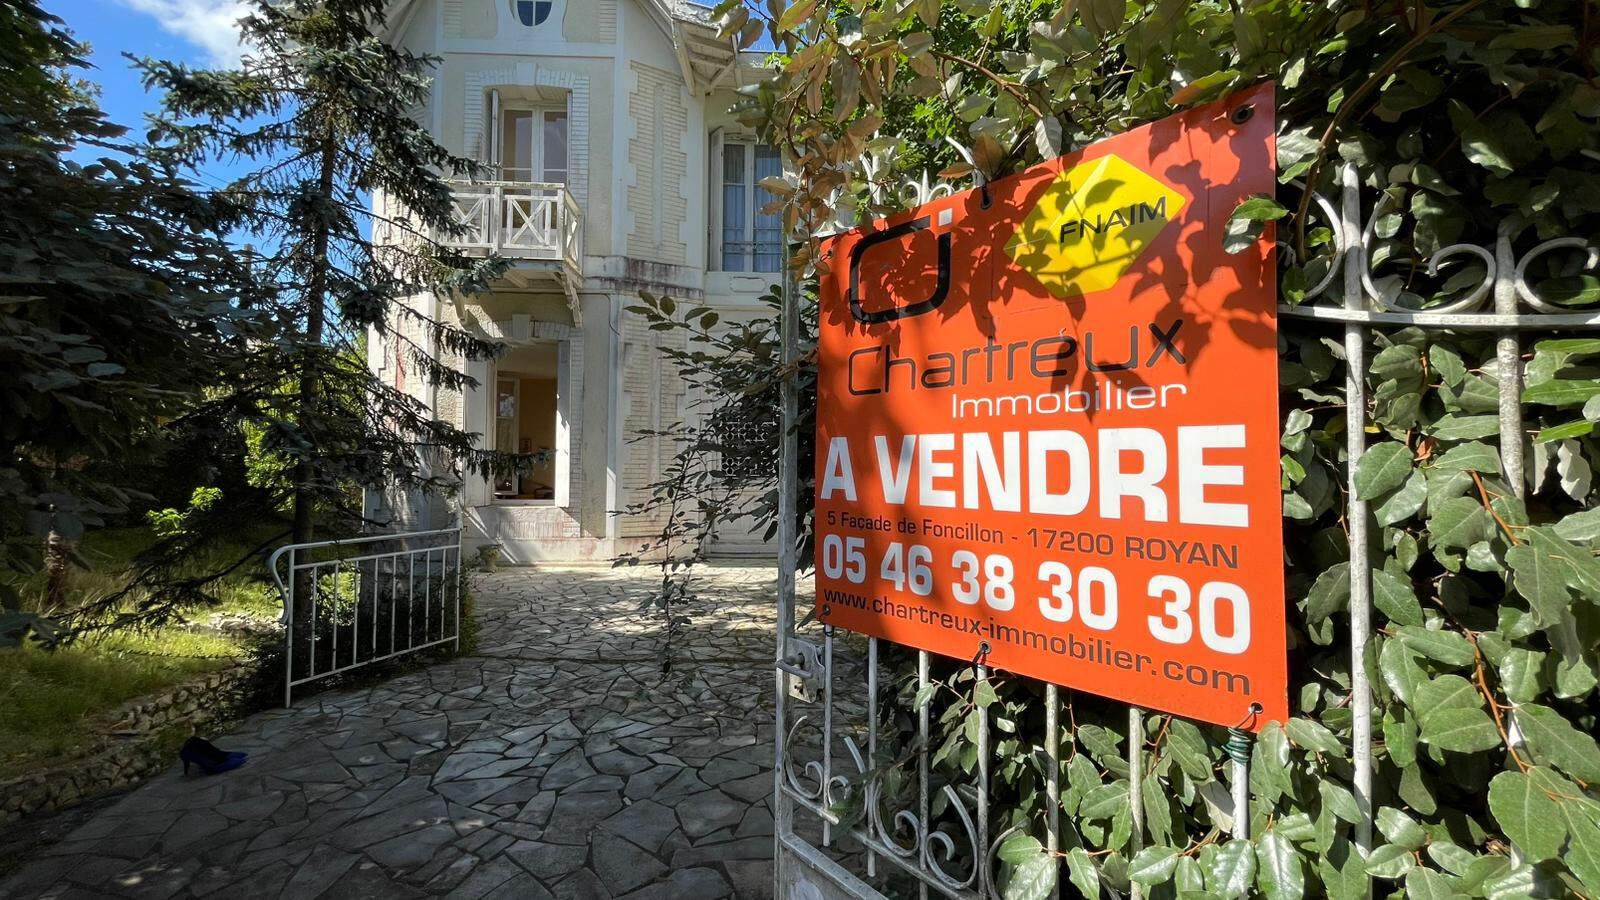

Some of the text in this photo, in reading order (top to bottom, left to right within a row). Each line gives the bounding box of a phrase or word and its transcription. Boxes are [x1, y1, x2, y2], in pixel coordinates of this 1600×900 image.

[1059, 196, 1168, 245] FNAIM
[951, 380, 1188, 419] Immobilier
[820, 424, 1250, 528] A VENDRE
[827, 510, 837, 527] 5
[897, 517, 916, 534] de
[922, 519, 1004, 545] Foncillon
[1027, 528, 1115, 556] 17200
[1125, 536, 1239, 569] ROYAN
[822, 534, 1252, 656] 05 46 38 30 30
[823, 586, 1251, 696] www.chartreux-immobilier.com
